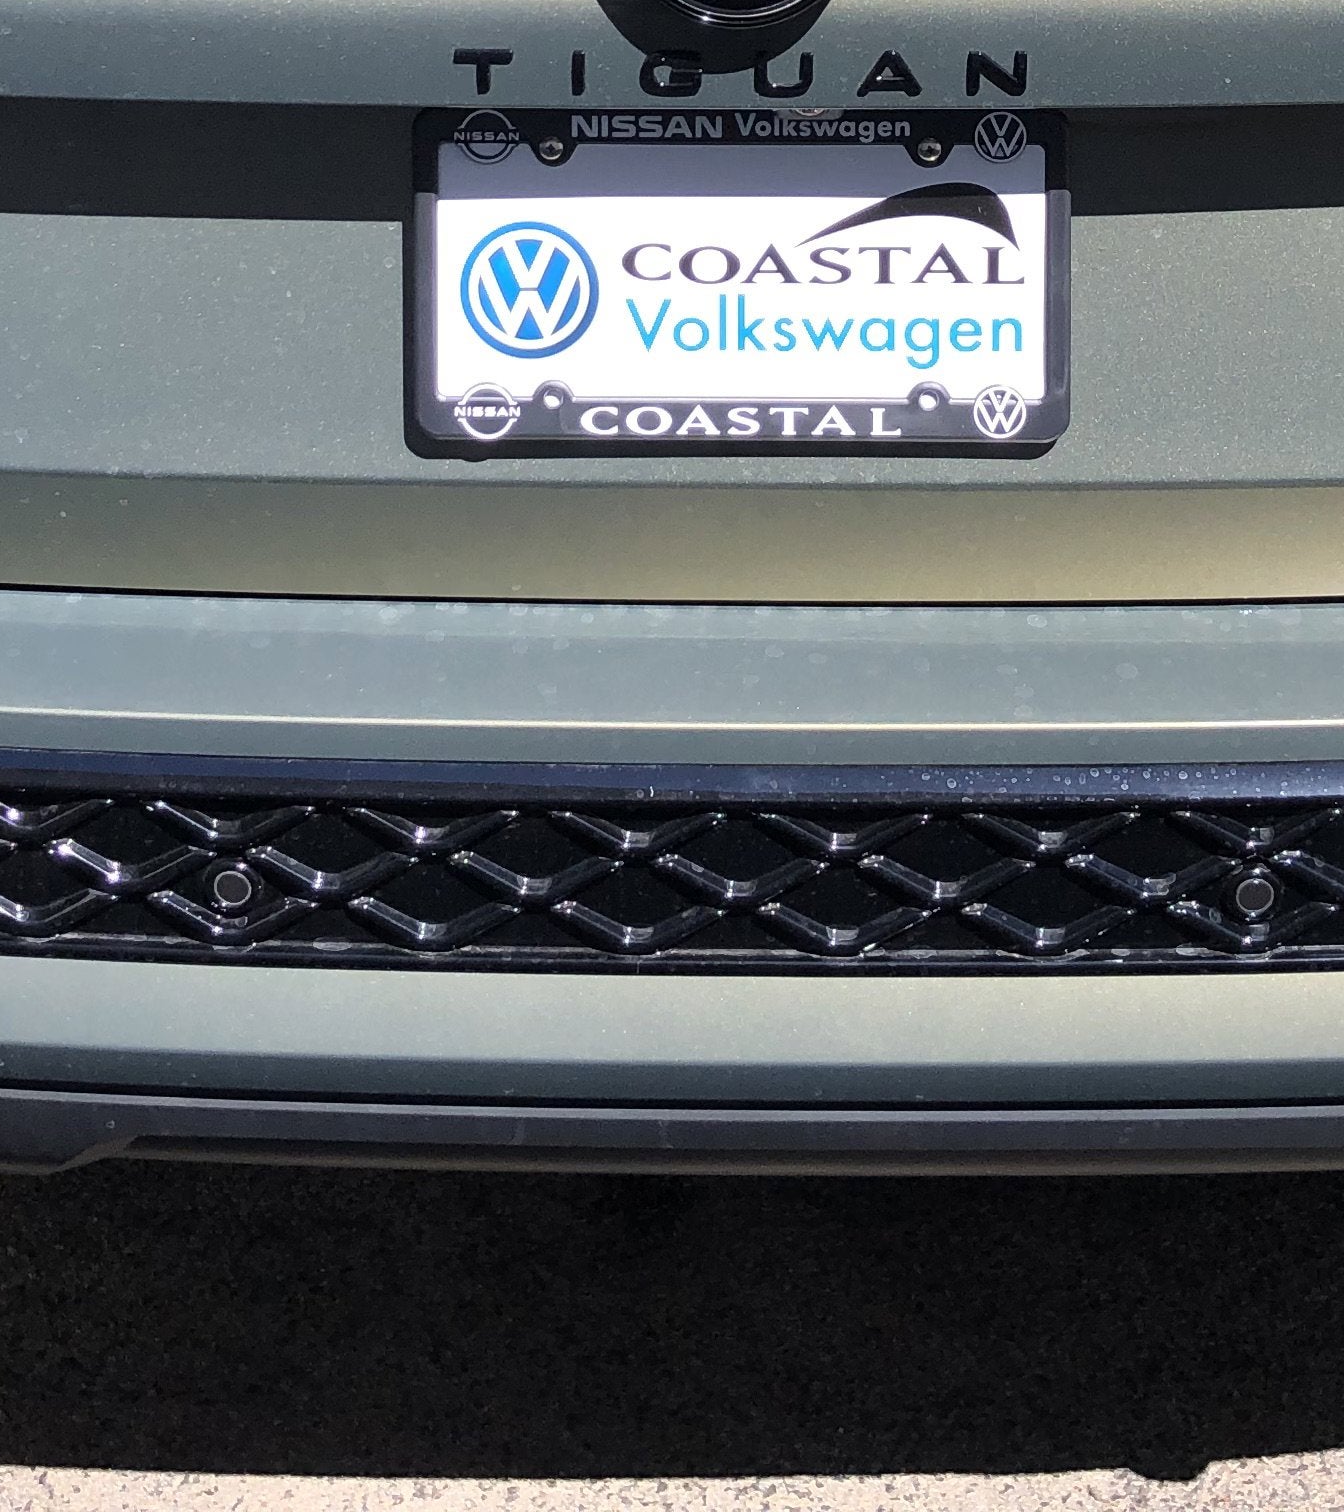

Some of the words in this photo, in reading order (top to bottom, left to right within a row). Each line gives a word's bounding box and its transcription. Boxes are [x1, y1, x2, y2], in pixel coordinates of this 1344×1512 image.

[453, 48, 1028, 98] TIGUAN
[453, 131, 520, 142] NISSAN
[571, 114, 723, 138] NISSAN
[734, 113, 911, 143] Volkswagen
[621, 242, 1025, 286] COASTAL
[625, 293, 1023, 368] Volkswagen
[453, 405, 521, 418] NISSAN
[579, 404, 902, 436] COASTAL
